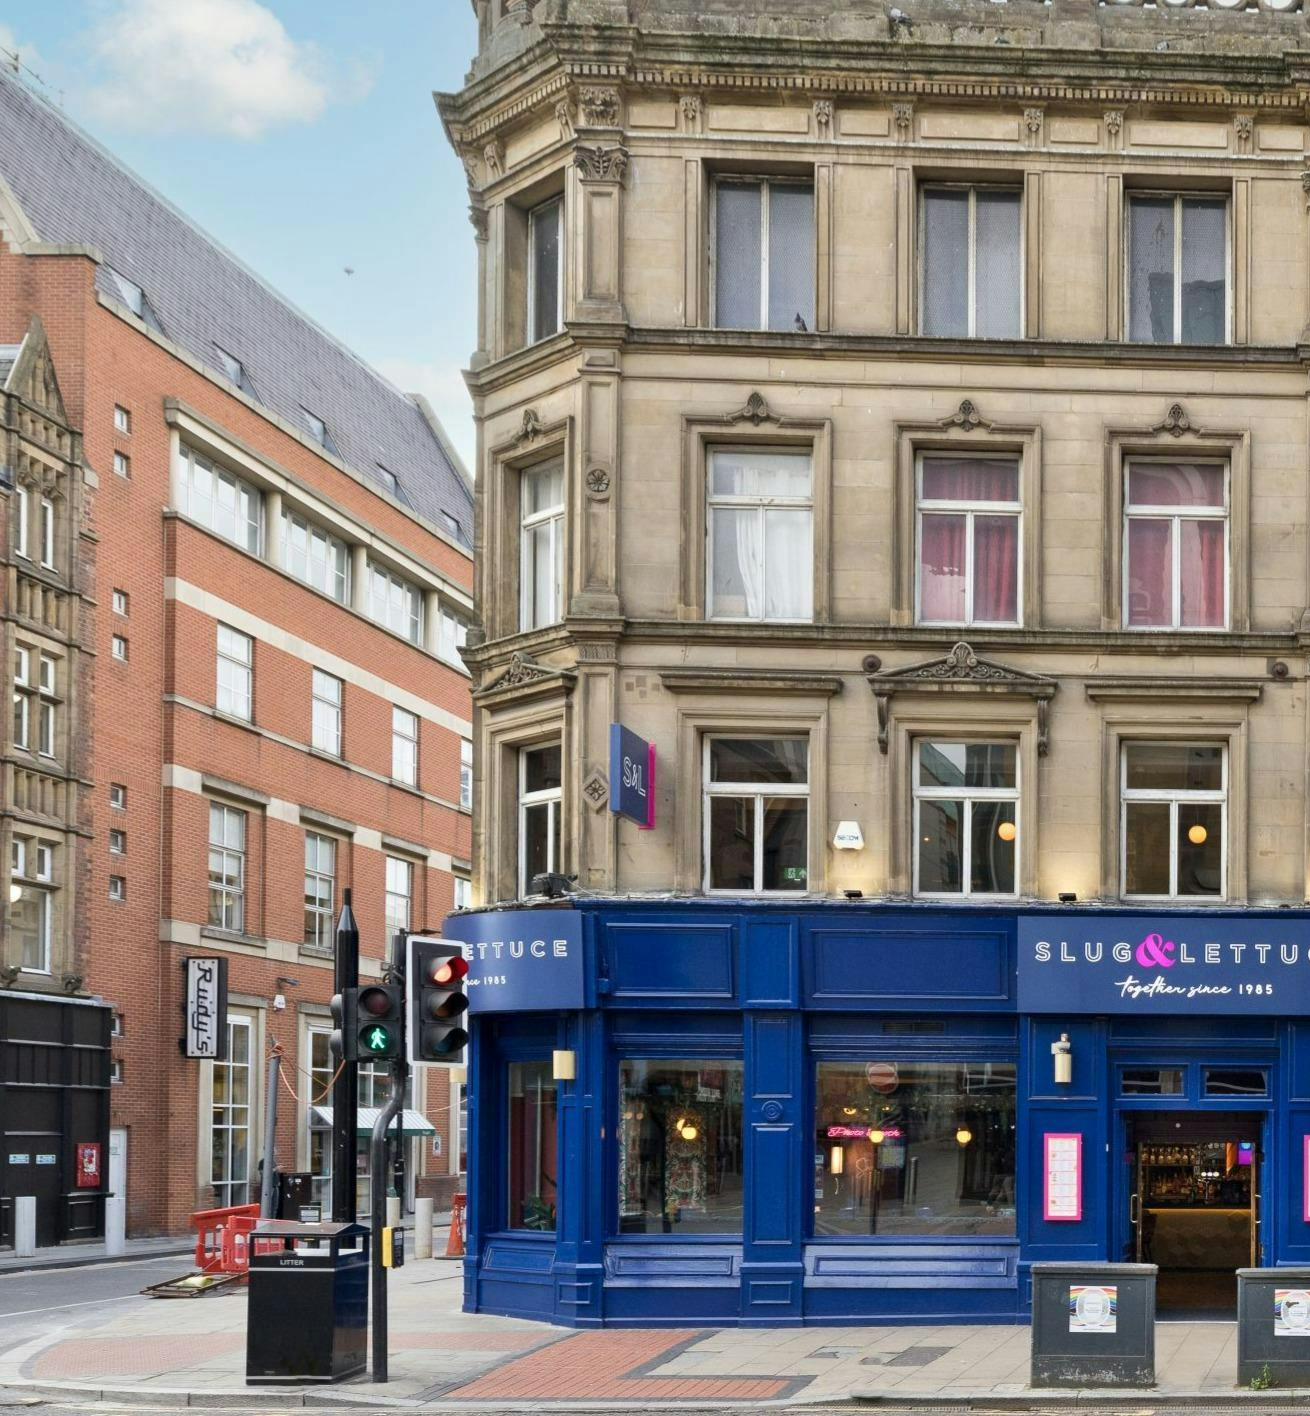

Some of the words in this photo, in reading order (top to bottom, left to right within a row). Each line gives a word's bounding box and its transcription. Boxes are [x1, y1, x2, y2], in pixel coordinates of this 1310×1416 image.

[622, 756, 646, 797] S&L
[483, 975, 506, 985] 1985
[1114, 975, 1186, 999] together
[1186, 983, 1232, 998] since
[1238, 983, 1274, 995] 1985
[191, 962, 213, 1053] Rudy's
[279, 1259, 304, 1267] LITTER
